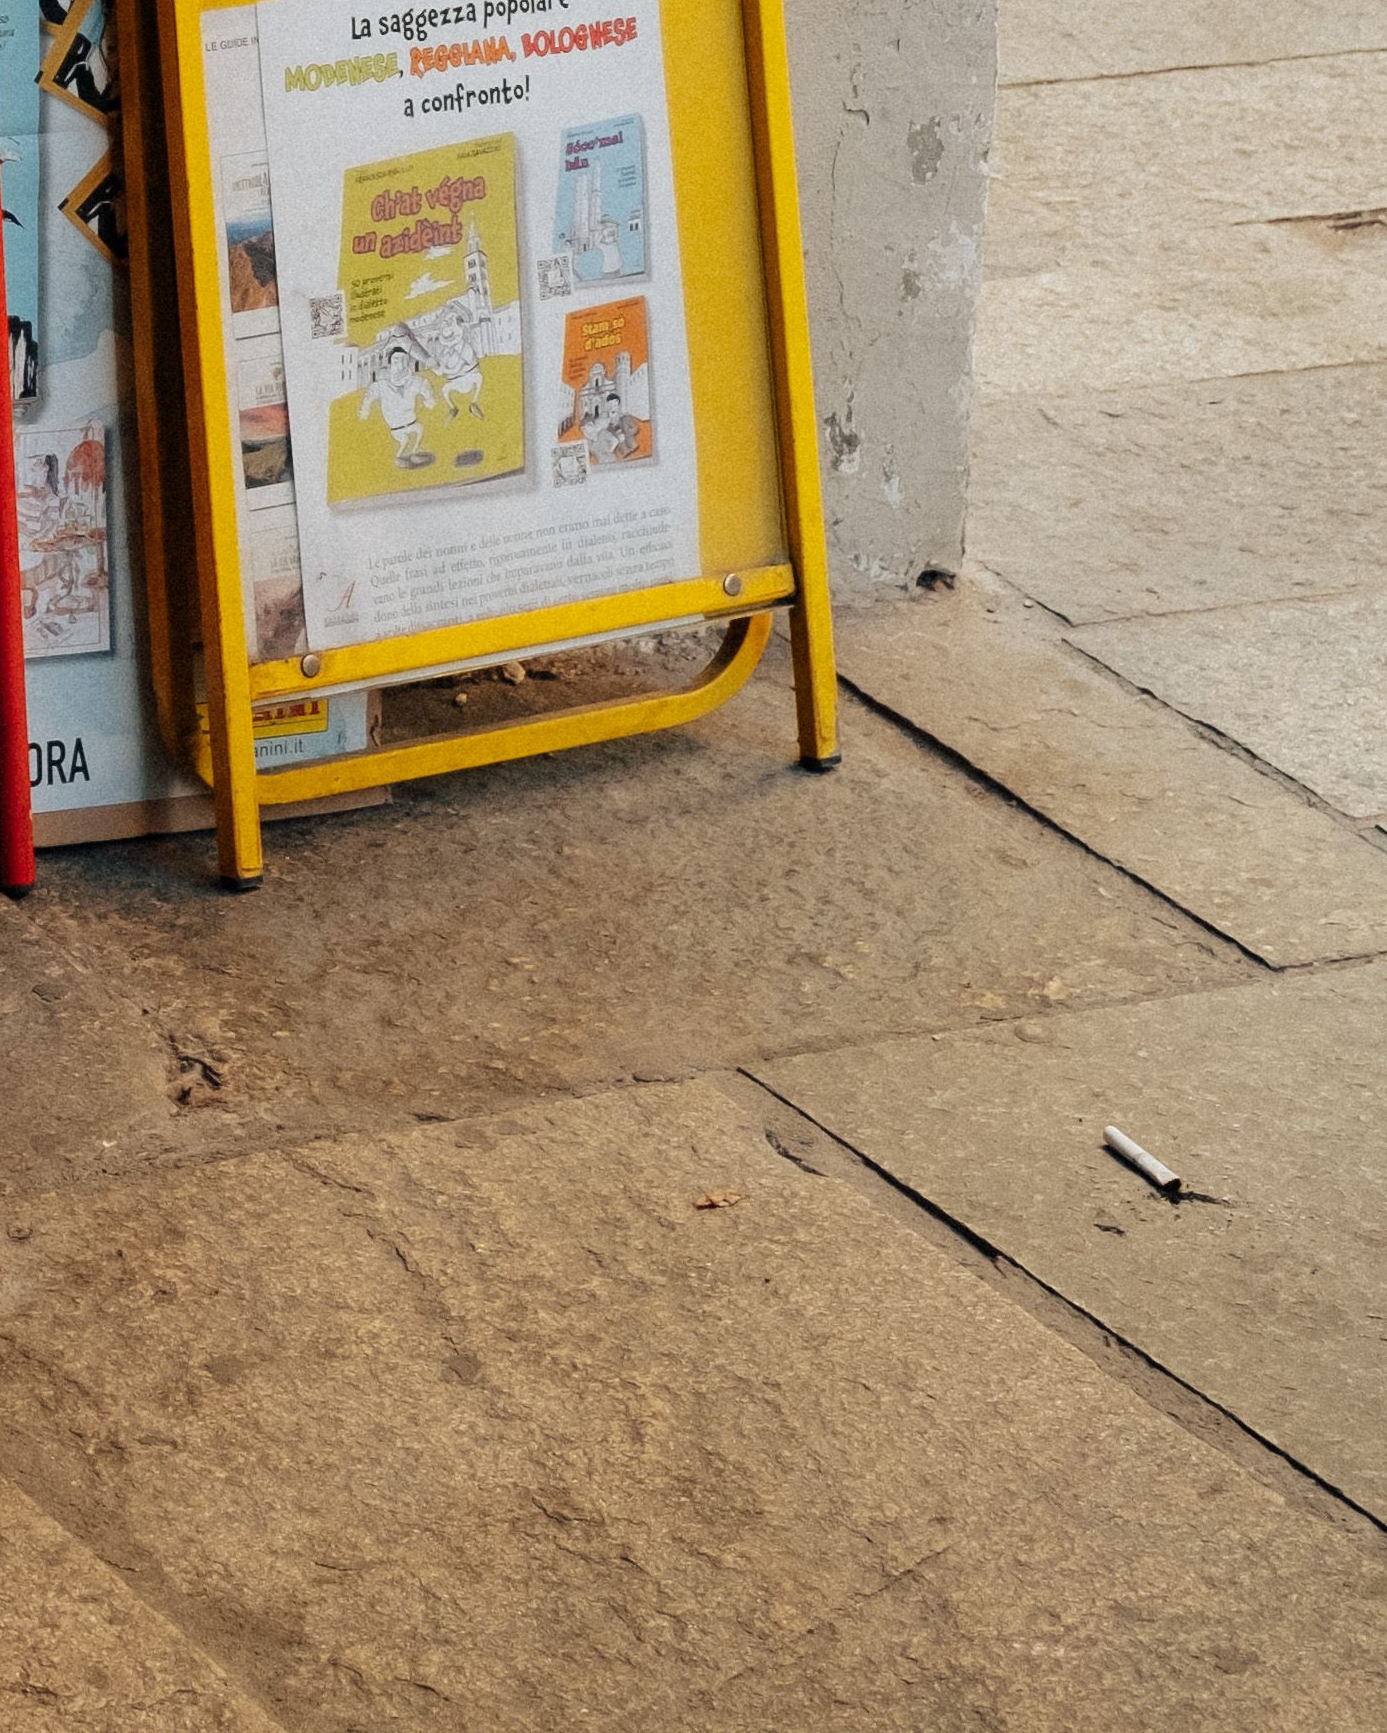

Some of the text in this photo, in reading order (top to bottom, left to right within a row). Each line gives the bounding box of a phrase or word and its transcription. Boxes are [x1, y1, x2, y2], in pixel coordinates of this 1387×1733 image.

[352, 15, 371, 39] La
[379, 2, 477, 41] saggezza
[284, 17, 637, 92] MODENESE, REGGIANA, BOLOGNESE
[404, 76, 530, 117] a confronto!
